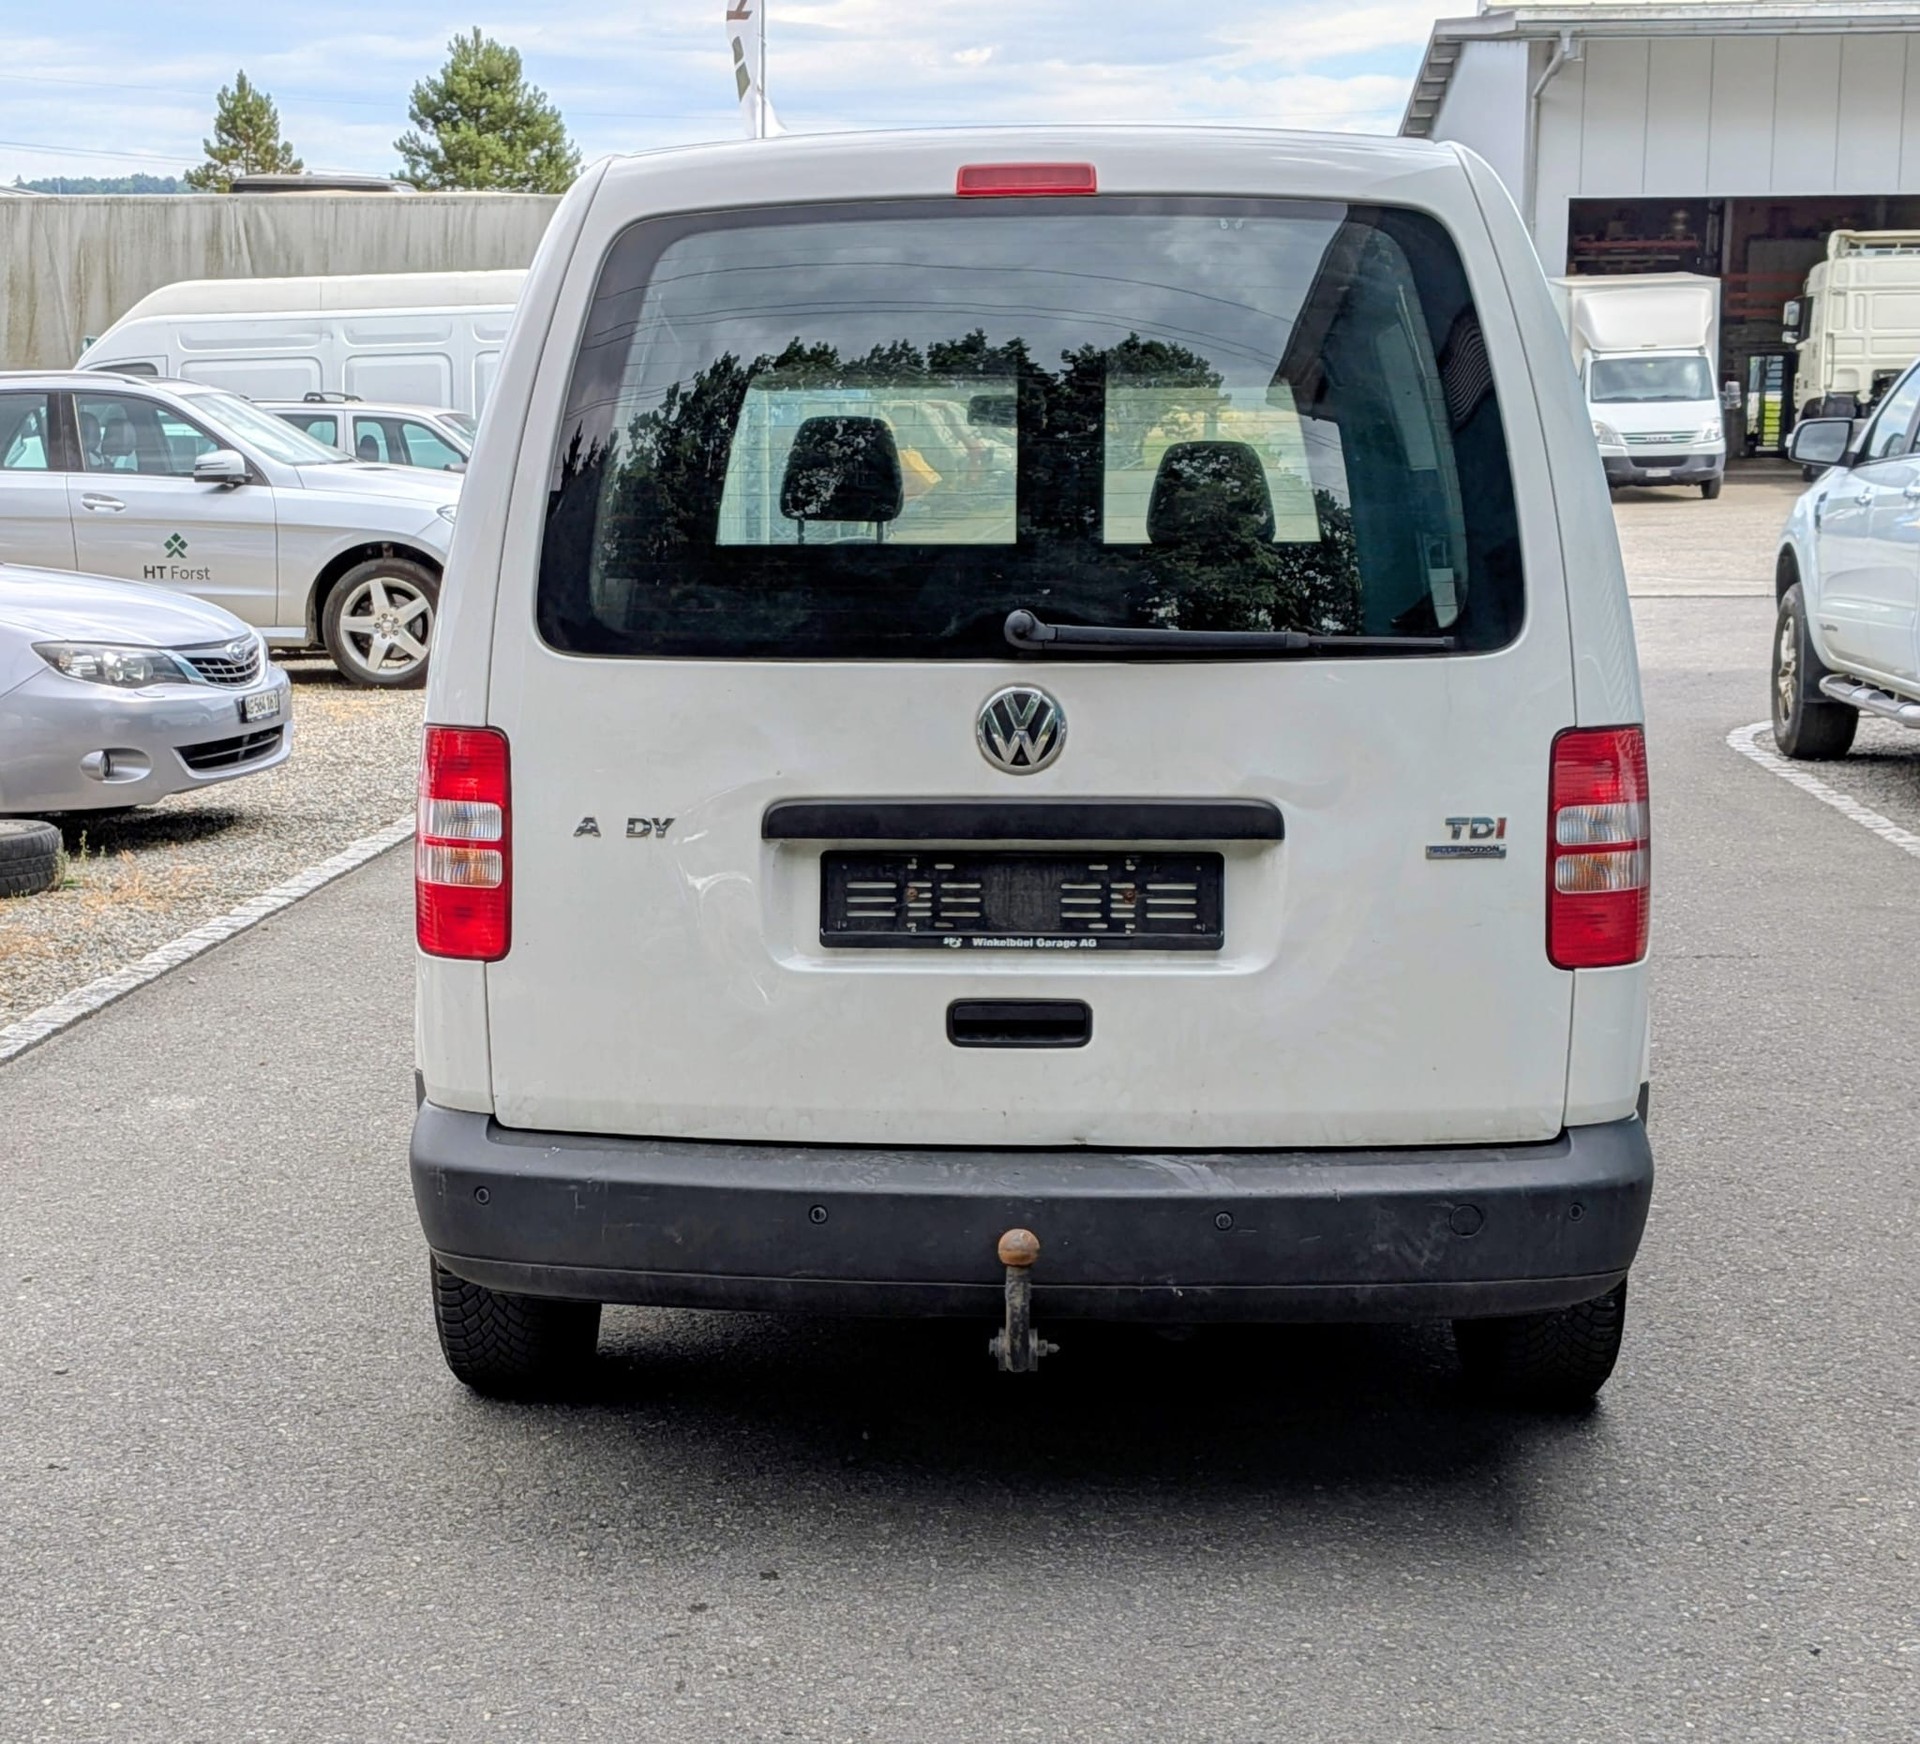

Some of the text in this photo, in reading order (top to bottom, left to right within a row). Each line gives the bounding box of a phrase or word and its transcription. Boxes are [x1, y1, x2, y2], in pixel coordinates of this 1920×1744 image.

[143, 565, 212, 581] HT Forst
[1445, 816, 1507, 840] TDI
[1036, 937, 1078, 949] Garage
[1079, 938, 1098, 948] AG
